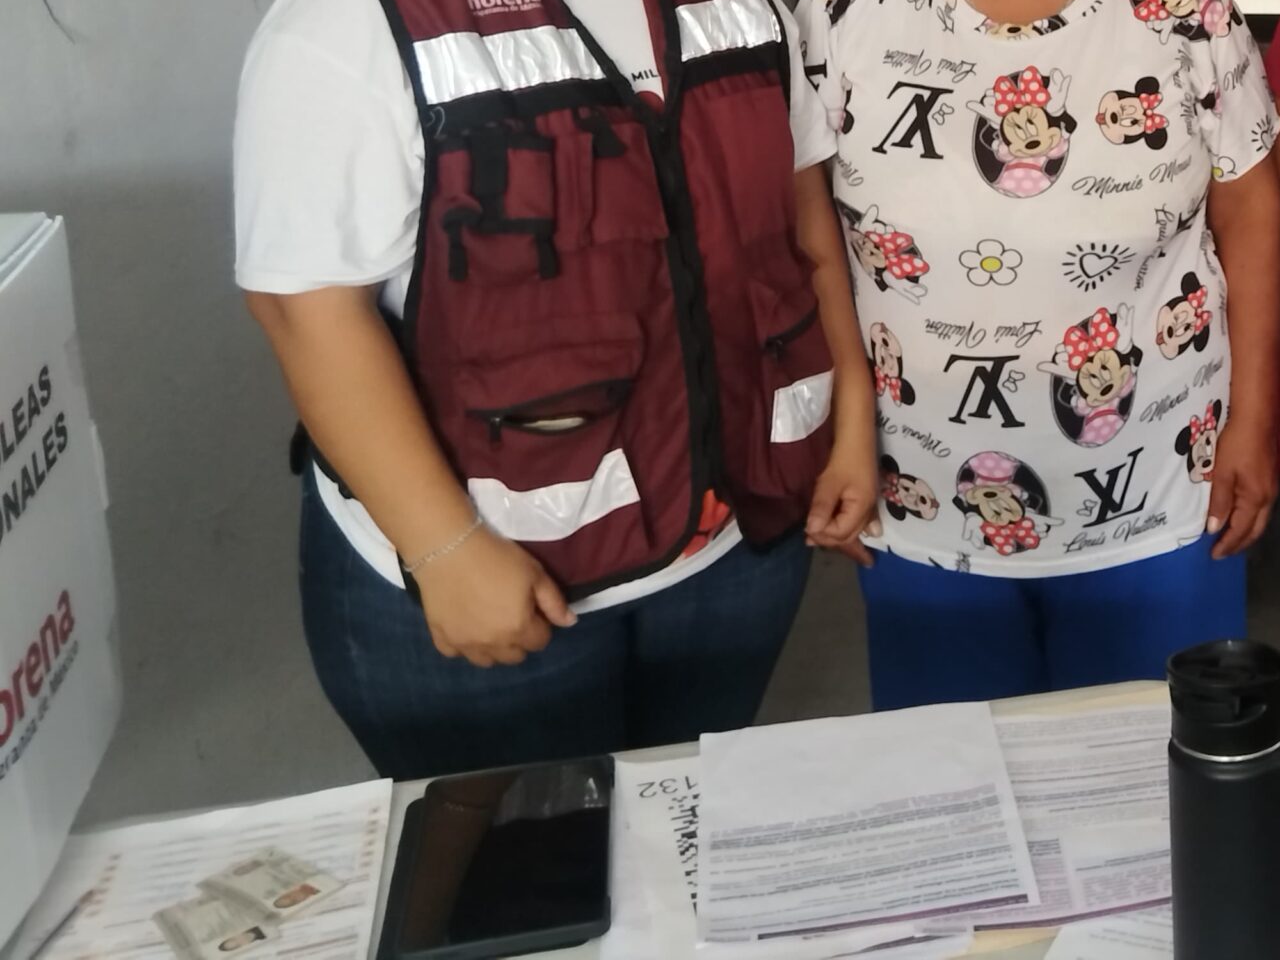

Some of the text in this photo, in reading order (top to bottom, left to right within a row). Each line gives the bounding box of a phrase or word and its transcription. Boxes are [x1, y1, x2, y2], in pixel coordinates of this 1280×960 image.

[1071, 175, 1144, 199] Minnie
[924, 318, 1043, 349] Louis Vuitton
[1062, 511, 1169, 554] Louis Vuitton
